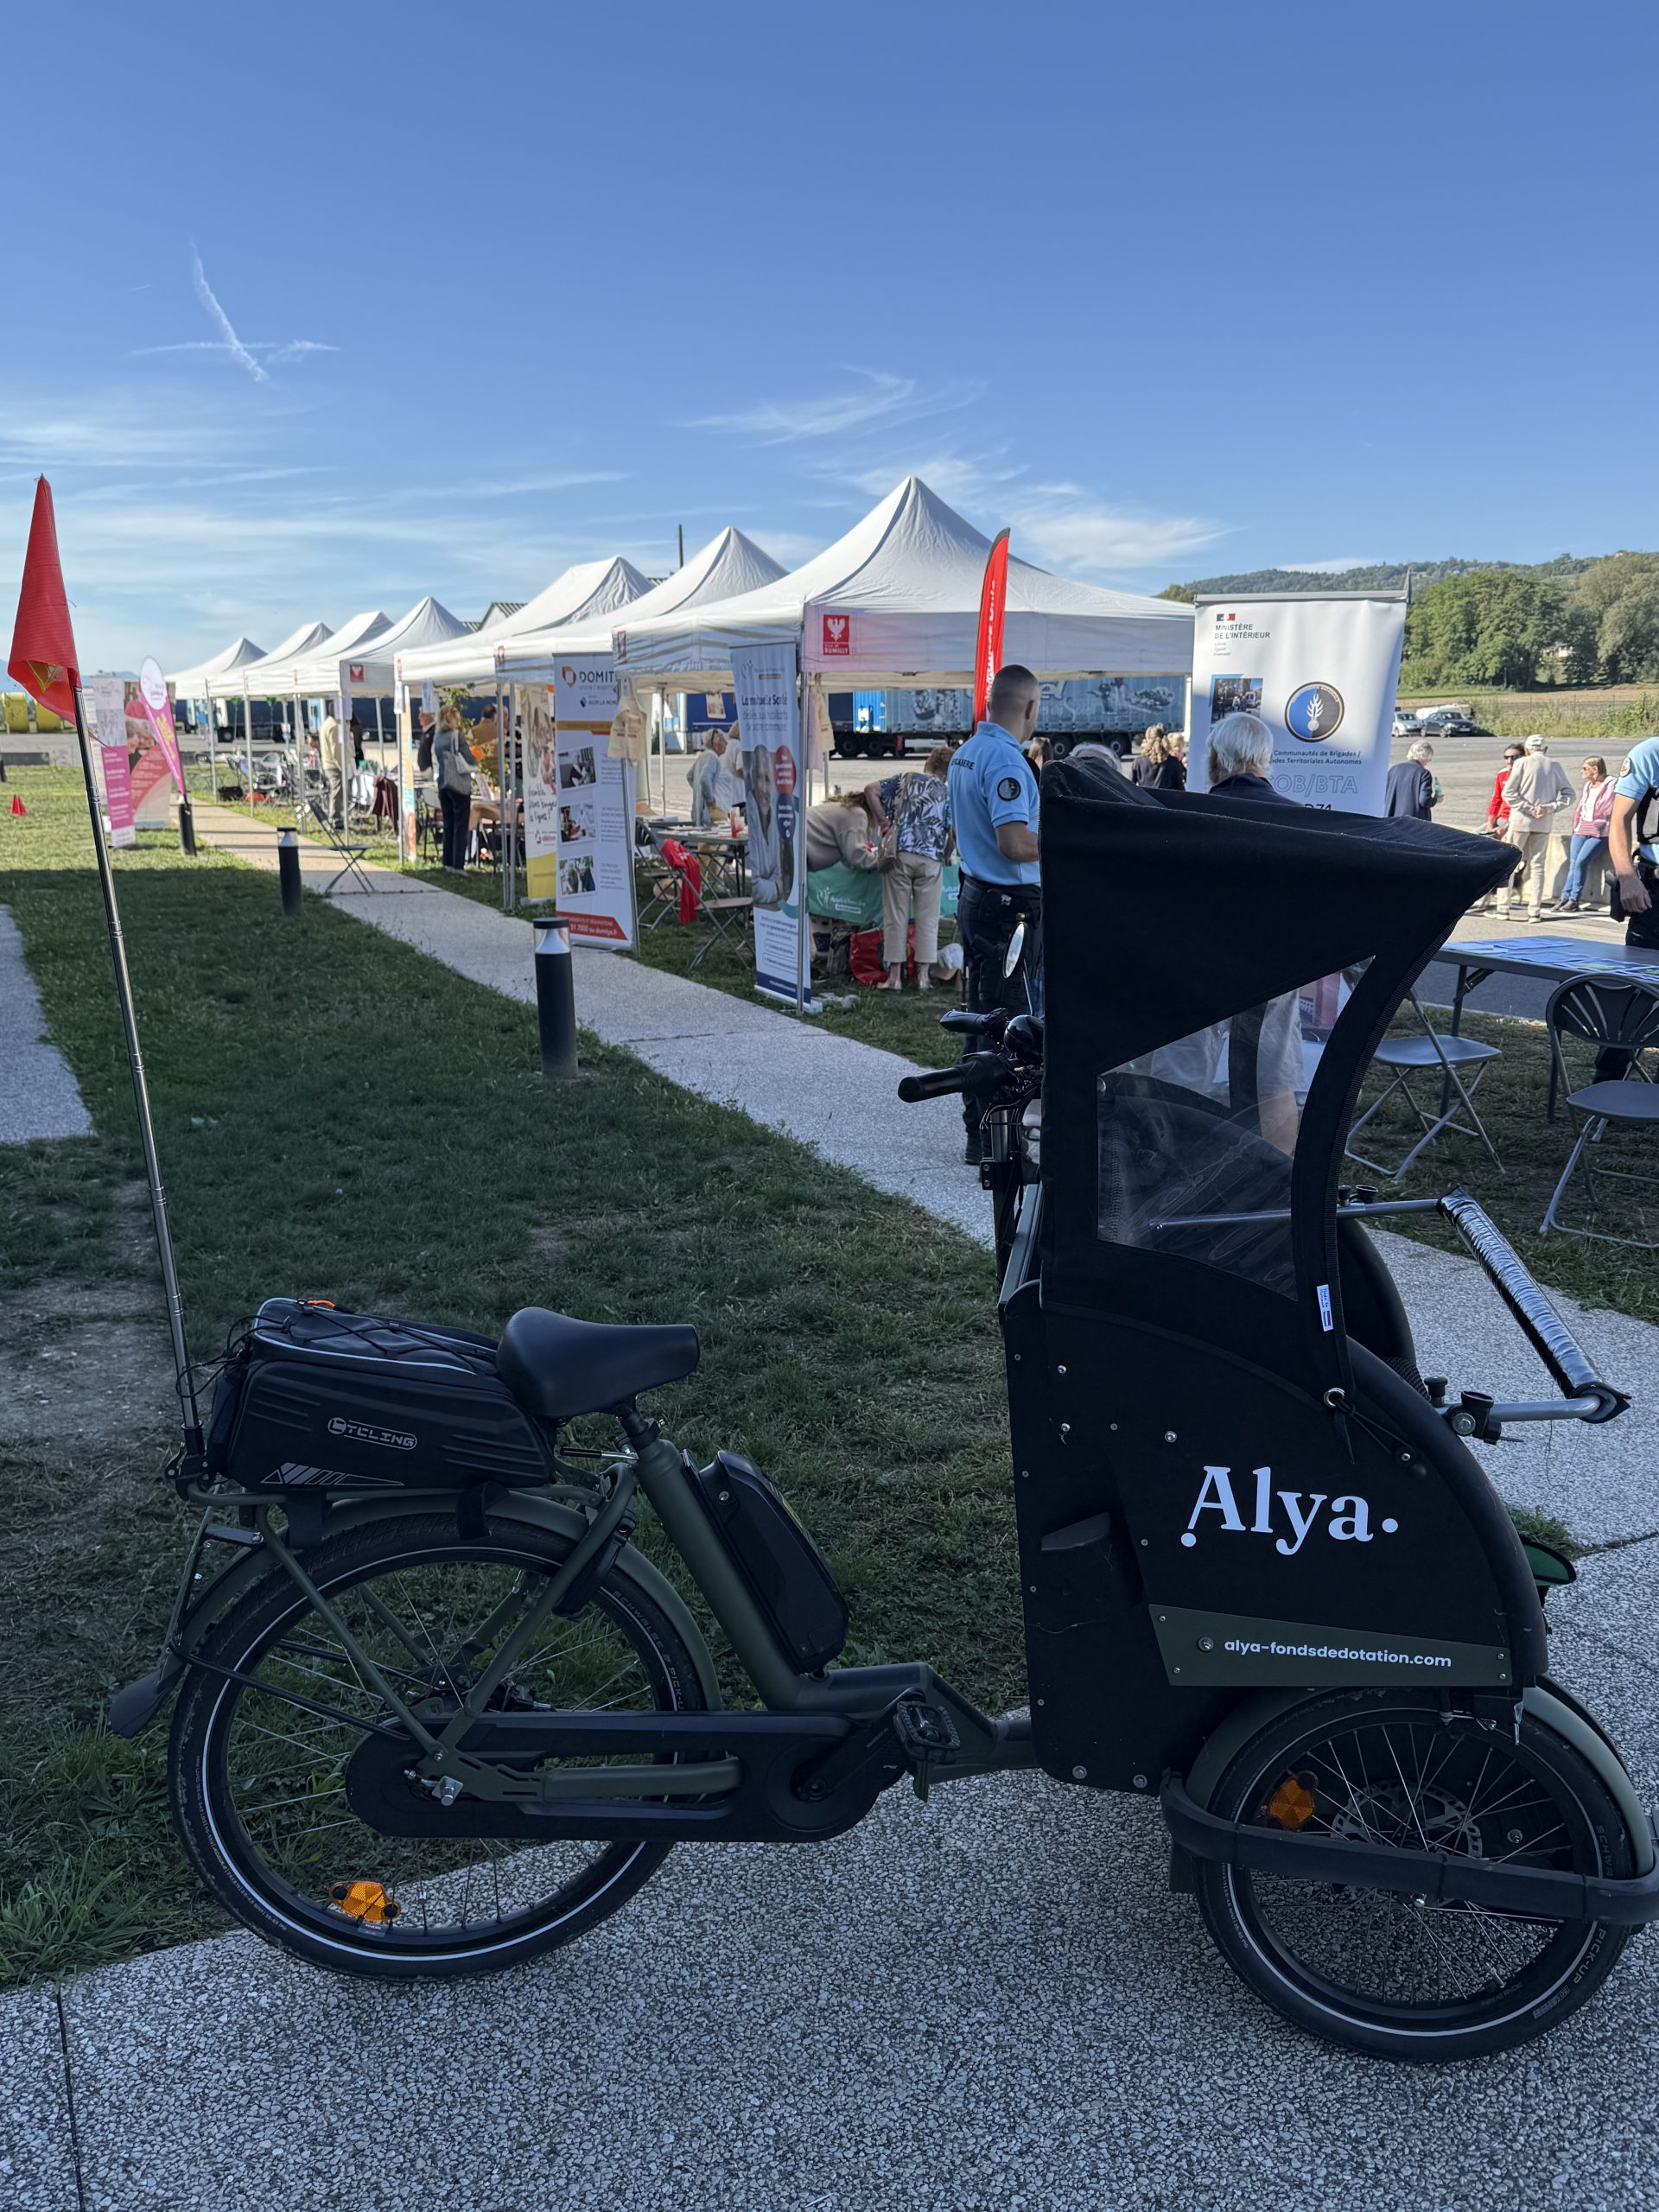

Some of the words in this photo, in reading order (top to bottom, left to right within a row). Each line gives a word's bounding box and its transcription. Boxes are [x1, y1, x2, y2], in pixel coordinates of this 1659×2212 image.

[580, 671, 614, 683] DOMIT
[1271, 774, 1358, 798] OB/BTA
[613, 1591, 664, 1649] SCHWALBE
[1224, 1639, 1452, 1667] alya-fondsdedotation.com
[668, 1667, 684, 1710] PICK-U
[1596, 1825, 1613, 1877] SCHWA
[1573, 1928, 1606, 1984] PICK-UP
